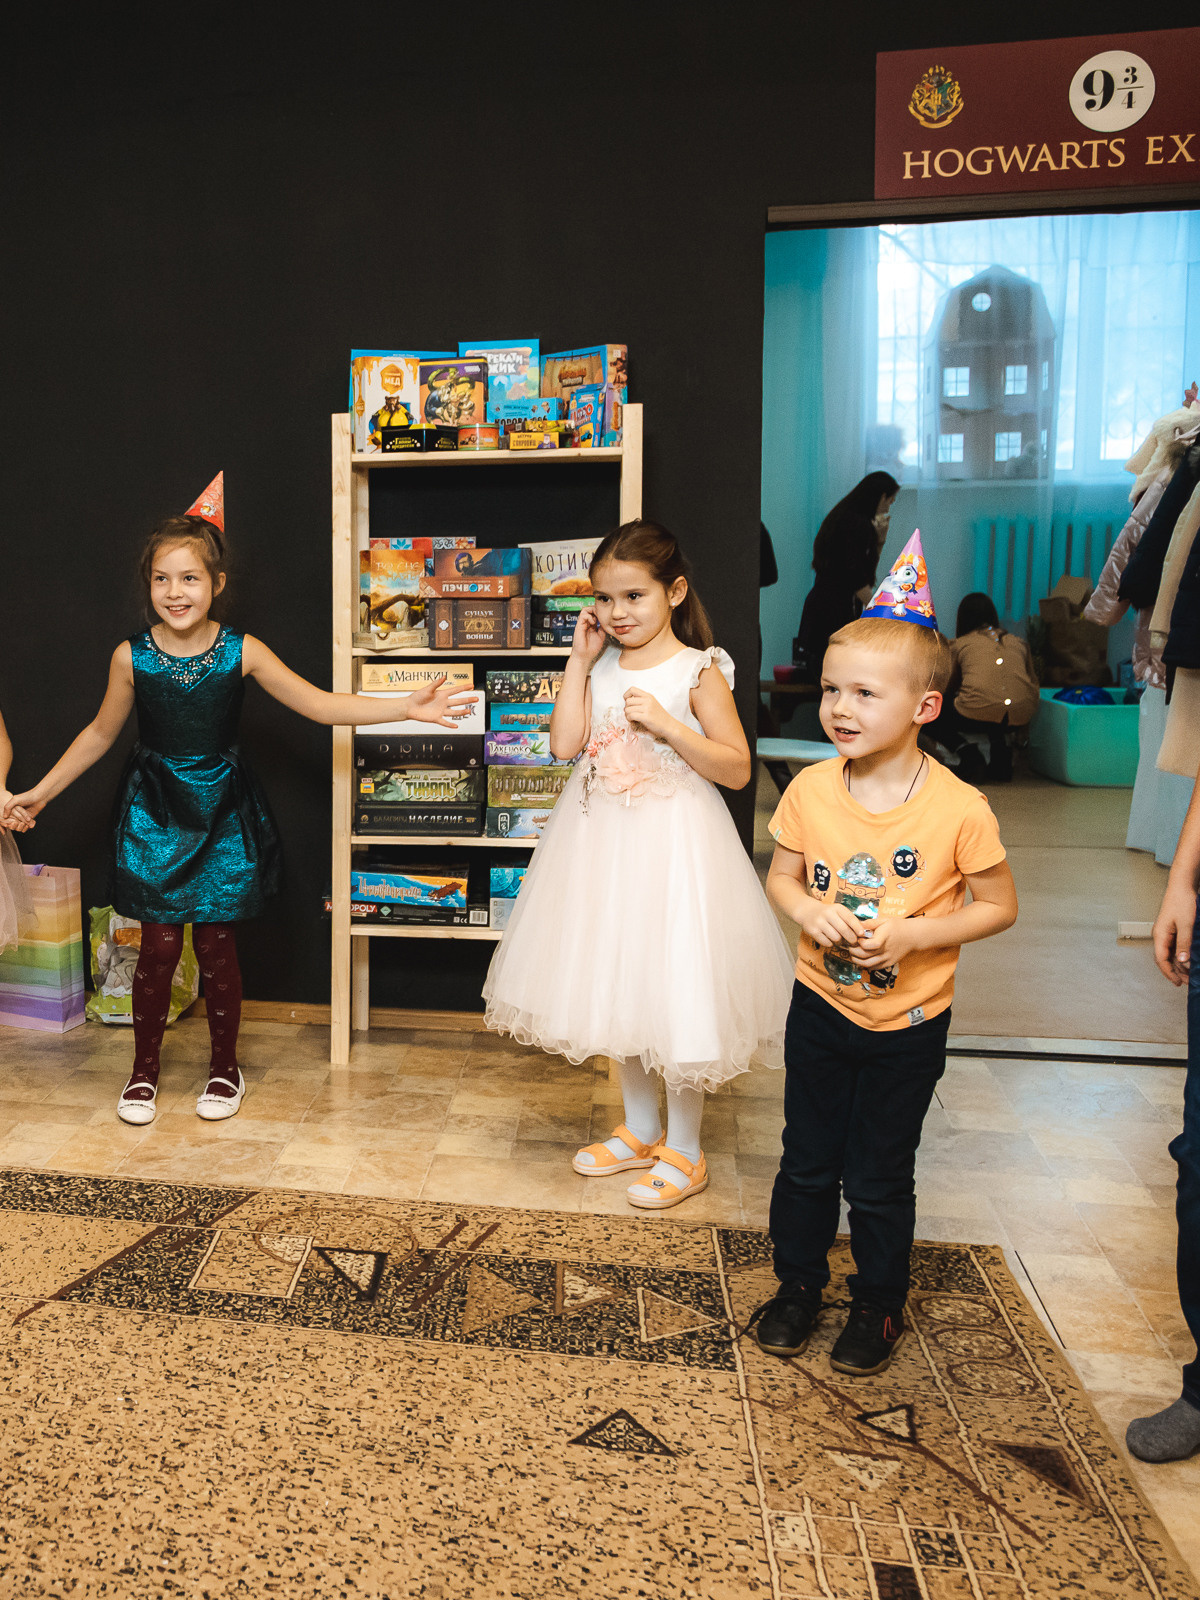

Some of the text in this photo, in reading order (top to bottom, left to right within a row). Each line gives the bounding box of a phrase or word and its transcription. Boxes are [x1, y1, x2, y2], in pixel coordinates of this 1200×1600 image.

[1082, 69, 1115, 112] 9
[902, 133, 1200, 180] HOGWARTS EX
[477, 352, 523, 364] РЕКАТИ
[487, 362, 516, 374] ЖИК
[384, 377, 401, 387] МЕД
[535, 551, 597, 573] КОТИК
[442, 583, 491, 593] ПЭЧВОРК
[464, 610, 494, 618] СУНДУК
[393, 670, 448, 683] Манчкин
[405, 780, 456, 799] ТИКАЛЬ
[408, 815, 463, 825] НАСЛЕДИЕ
[325, 902, 376, 913] MPOLY
